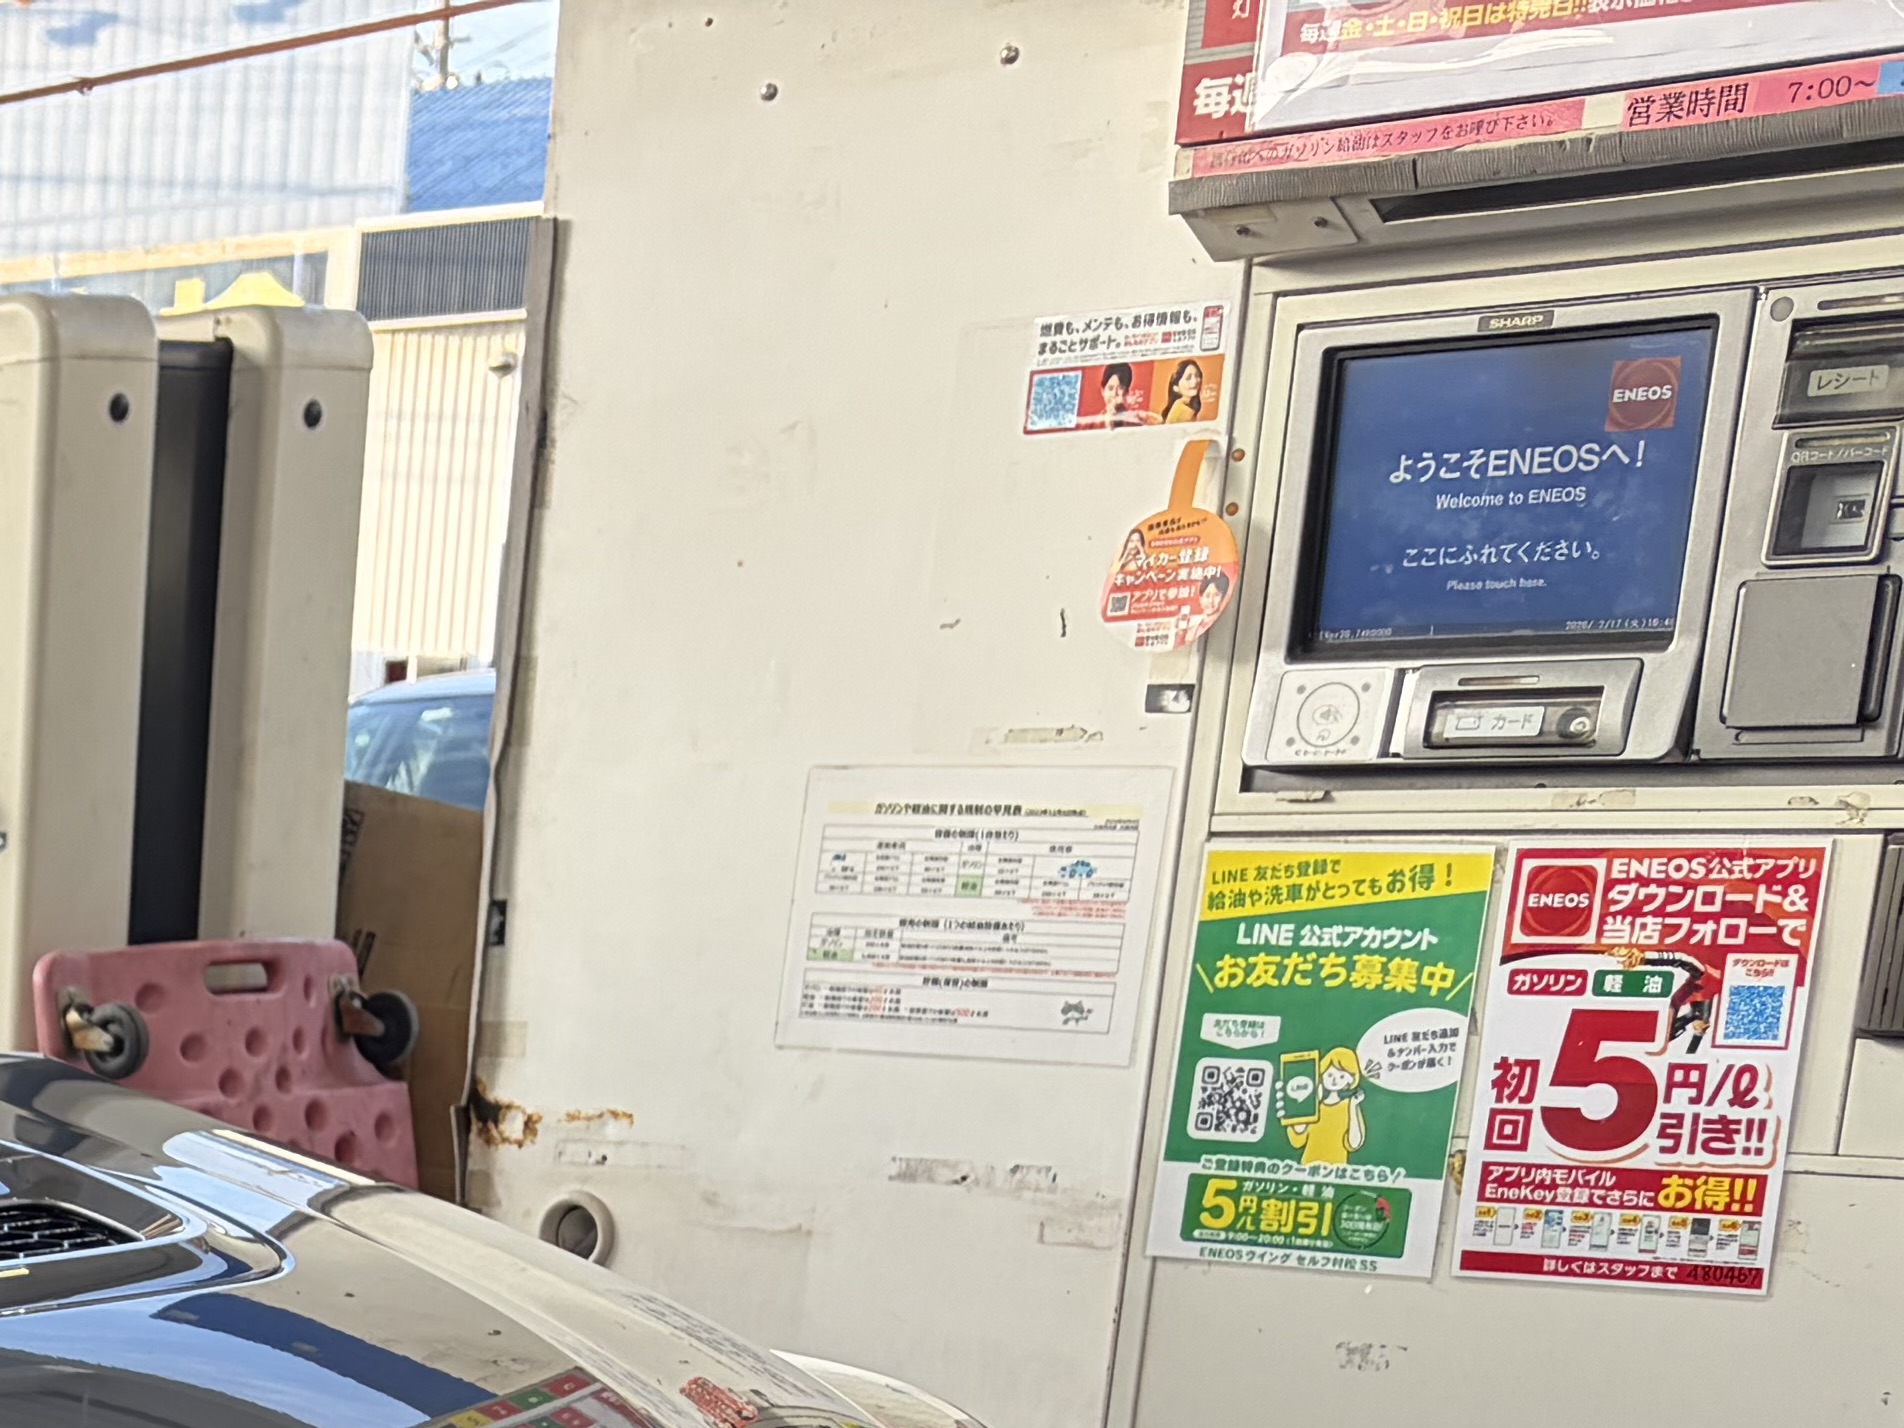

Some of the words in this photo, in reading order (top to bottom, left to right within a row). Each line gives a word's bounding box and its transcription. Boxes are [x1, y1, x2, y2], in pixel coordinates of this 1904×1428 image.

[1627, 82, 1749, 128] 営業時間
[1489, 315, 1544, 329] SHARP
[1817, 369, 1880, 391] レシート
[1612, 385, 1672, 403] ENEOS
[1436, 491, 1504, 510] Welcome
[1508, 491, 1524, 506] to
[1528, 487, 1587, 505] ENEOS
[1402, 539, 1601, 568] ここにふれてください。
[1446, 578, 1483, 591] Please
[1485, 577, 1517, 590] touch
[1491, 713, 1535, 731] カード
[1212, 866, 1249, 885] LINE
[1253, 859, 1342, 882] 友だち登録で
[1610, 857, 1818, 881] ENEOS公式アプリ
[1527, 893, 1591, 908] ENEOS
[1237, 923, 1295, 946] LINE
[1299, 923, 1439, 951] 公式アカウント
[1600, 917, 1807, 946] 当店フォローで
[1213, 951, 1455, 997] お友だち募集中
[1513, 973, 1583, 992] ガソリン
[1384, 1033, 1409, 1045] LINE
[1539, 1008, 1660, 1152] 5
[1486, 1166, 1617, 1187] アプリ内モバイル
[1200, 1178, 1238, 1229] 5
[1485, 1183, 1655, 1208] EneKey登録でさらに
[1260, 1198, 1333, 1238] 割引
[1542, 1258, 1679, 1279] 詳しくはスタッフまで
